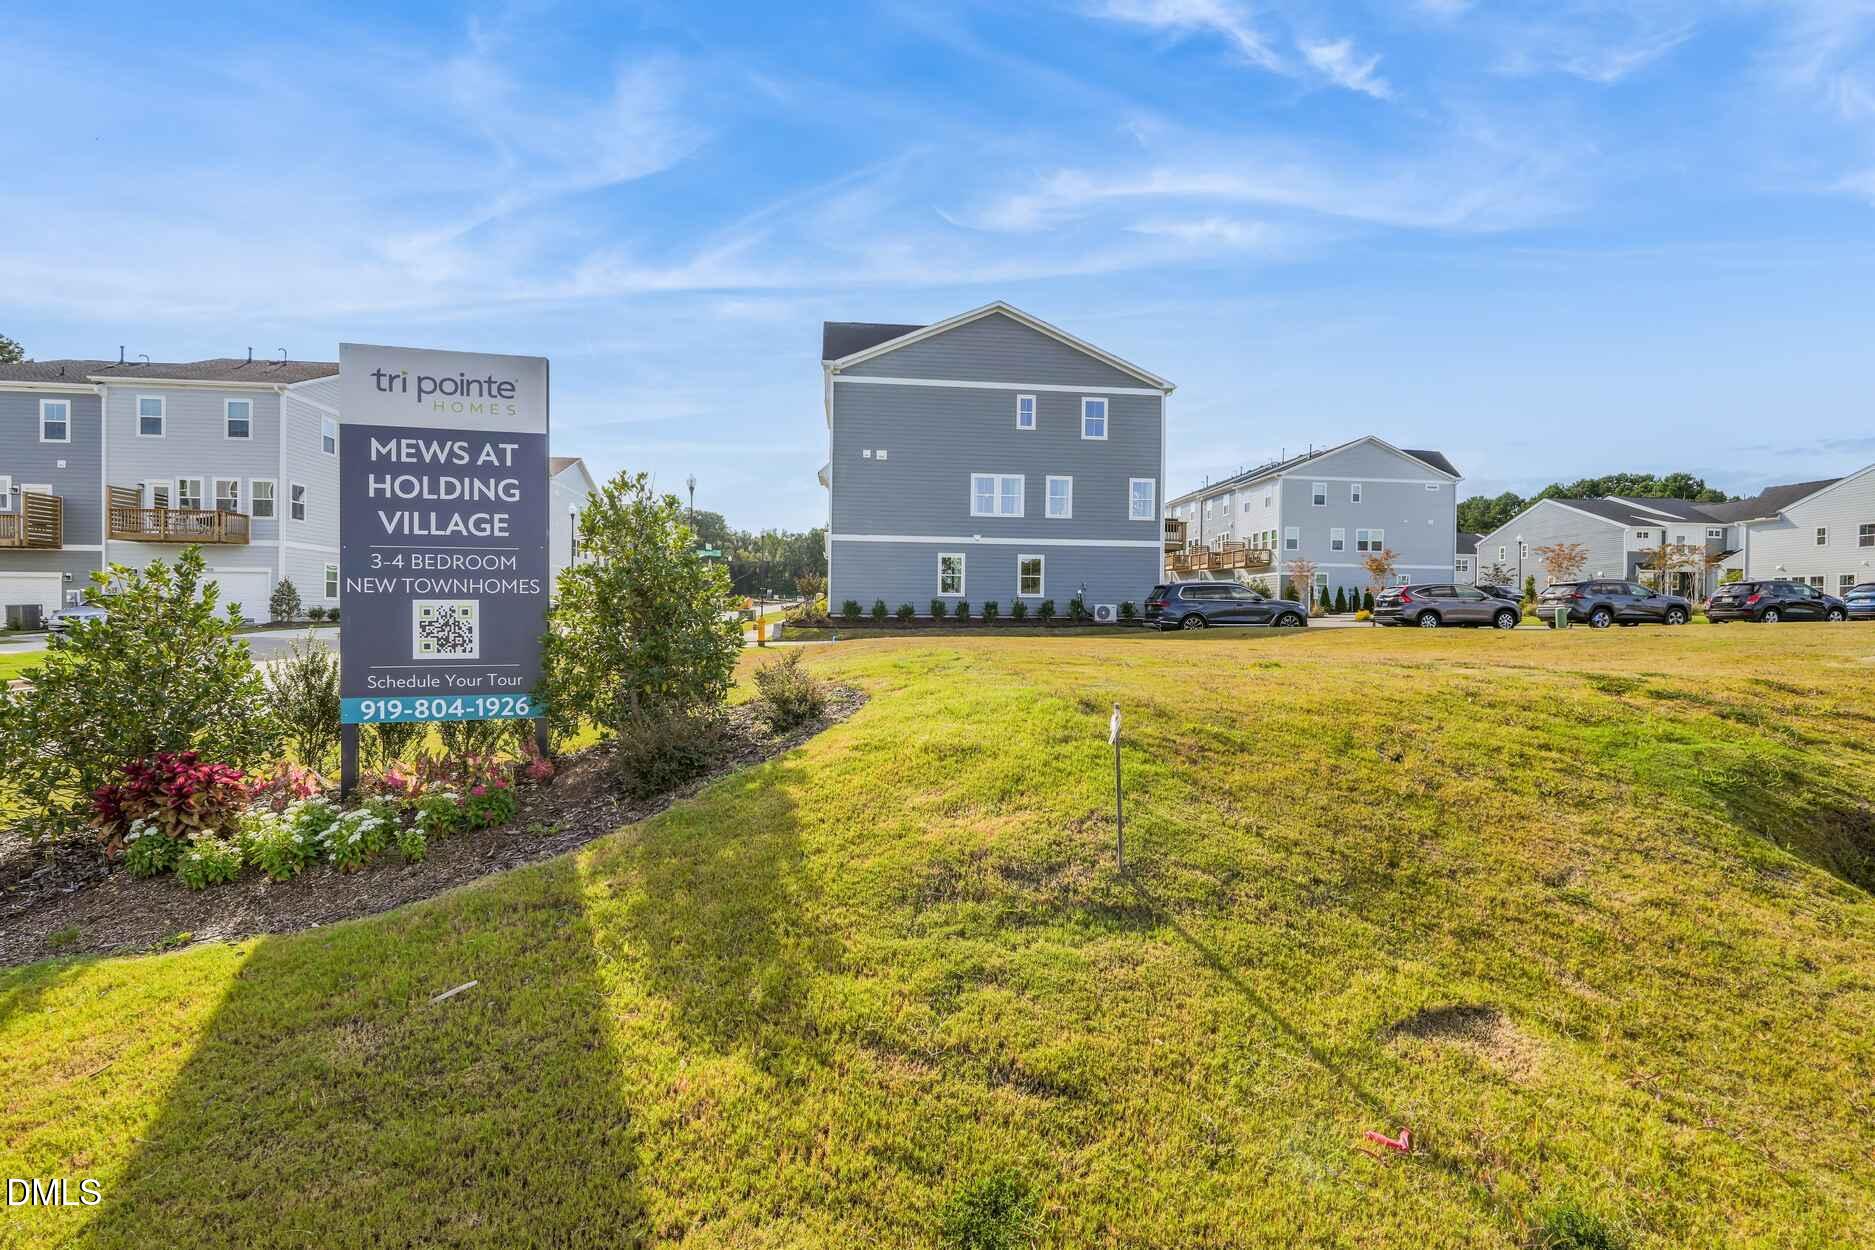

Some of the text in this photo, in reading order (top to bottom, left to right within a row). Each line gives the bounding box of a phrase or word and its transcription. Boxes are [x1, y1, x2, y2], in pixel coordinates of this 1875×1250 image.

[370, 368, 516, 403] tri pointe
[433, 400, 517, 416] HOMES
[370, 437, 519, 467] MEWS AT
[368, 474, 521, 502] HOLDING
[377, 510, 511, 537] VILLAGE
[370, 553, 517, 571] 3-4 BEDROOM
[346, 577, 541, 595] NEW TOWNHOMES
[367, 673, 524, 689] Schedule Your Tour
[360, 696, 530, 721] 919-804-1926
